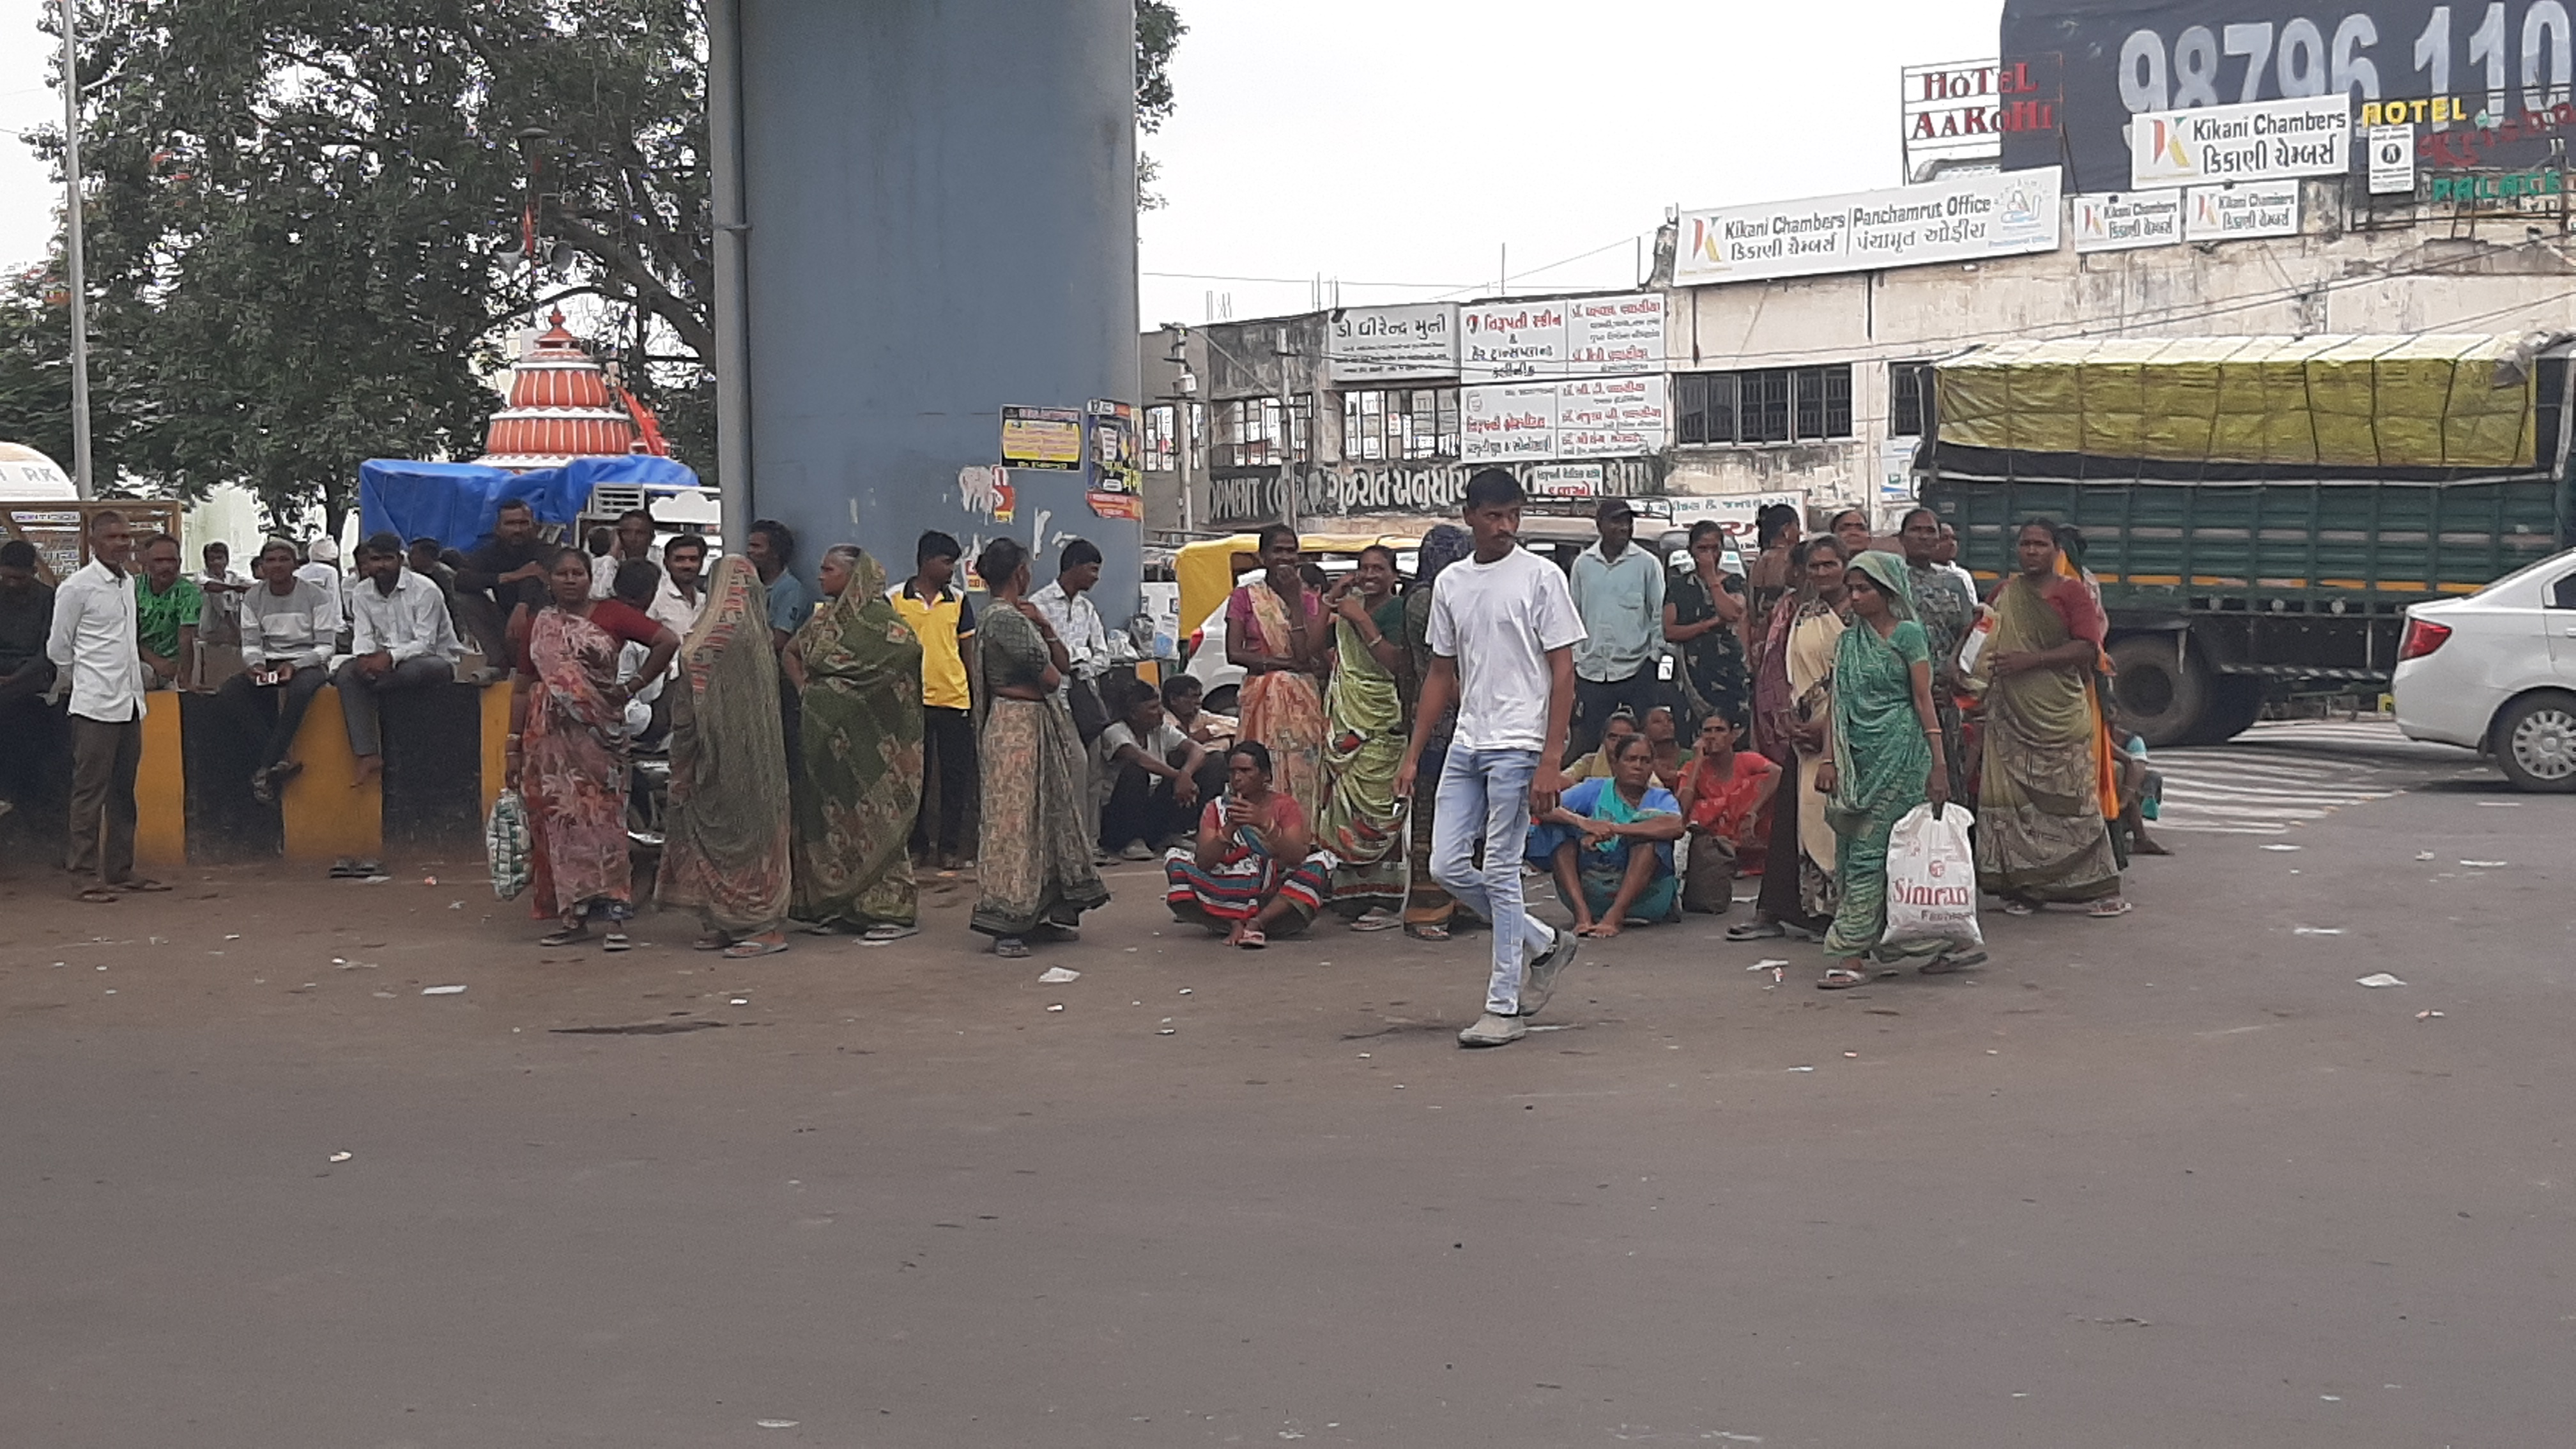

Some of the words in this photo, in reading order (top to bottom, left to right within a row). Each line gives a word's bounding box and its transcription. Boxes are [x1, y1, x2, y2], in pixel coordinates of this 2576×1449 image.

[2193, 116, 2248, 142] Kikani
[2253, 109, 2347, 135] Chambers
[2362, 96, 2467, 128] HOTEL
[2433, 171, 2562, 202] PALACE
[1725, 217, 1770, 240] Kikani
[1772, 211, 1846, 235] Chambers
[1853, 202, 1943, 227] Panchamrut
[1947, 194, 1991, 217] Office
[1892, 877, 1969, 906] Simran
